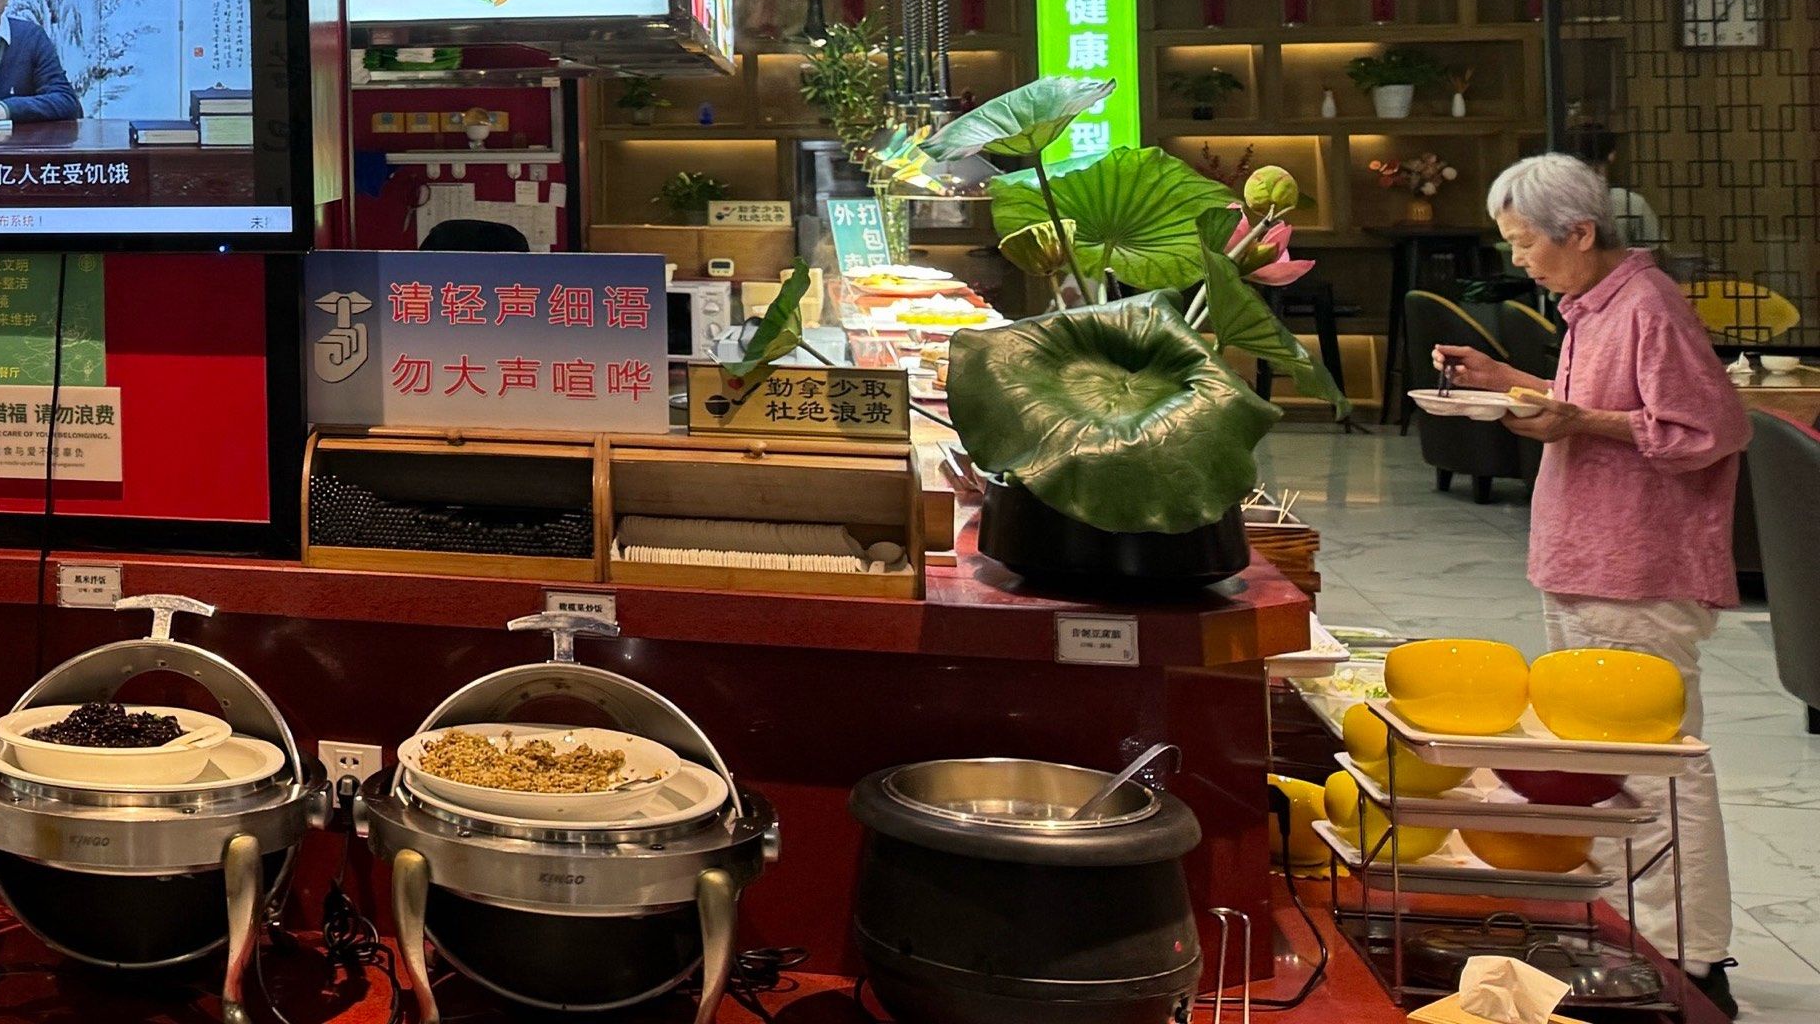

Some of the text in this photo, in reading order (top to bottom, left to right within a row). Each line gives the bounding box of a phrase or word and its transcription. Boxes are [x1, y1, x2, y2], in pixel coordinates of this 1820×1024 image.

[388, 281, 652, 329] 请轻声细语
[390, 352, 654, 404] 勿大声喧哗
[764, 376, 892, 399] 勤拿少取
[34, 403, 116, 425] 请勿浪费
[764, 400, 893, 424] 杜绝浪费
